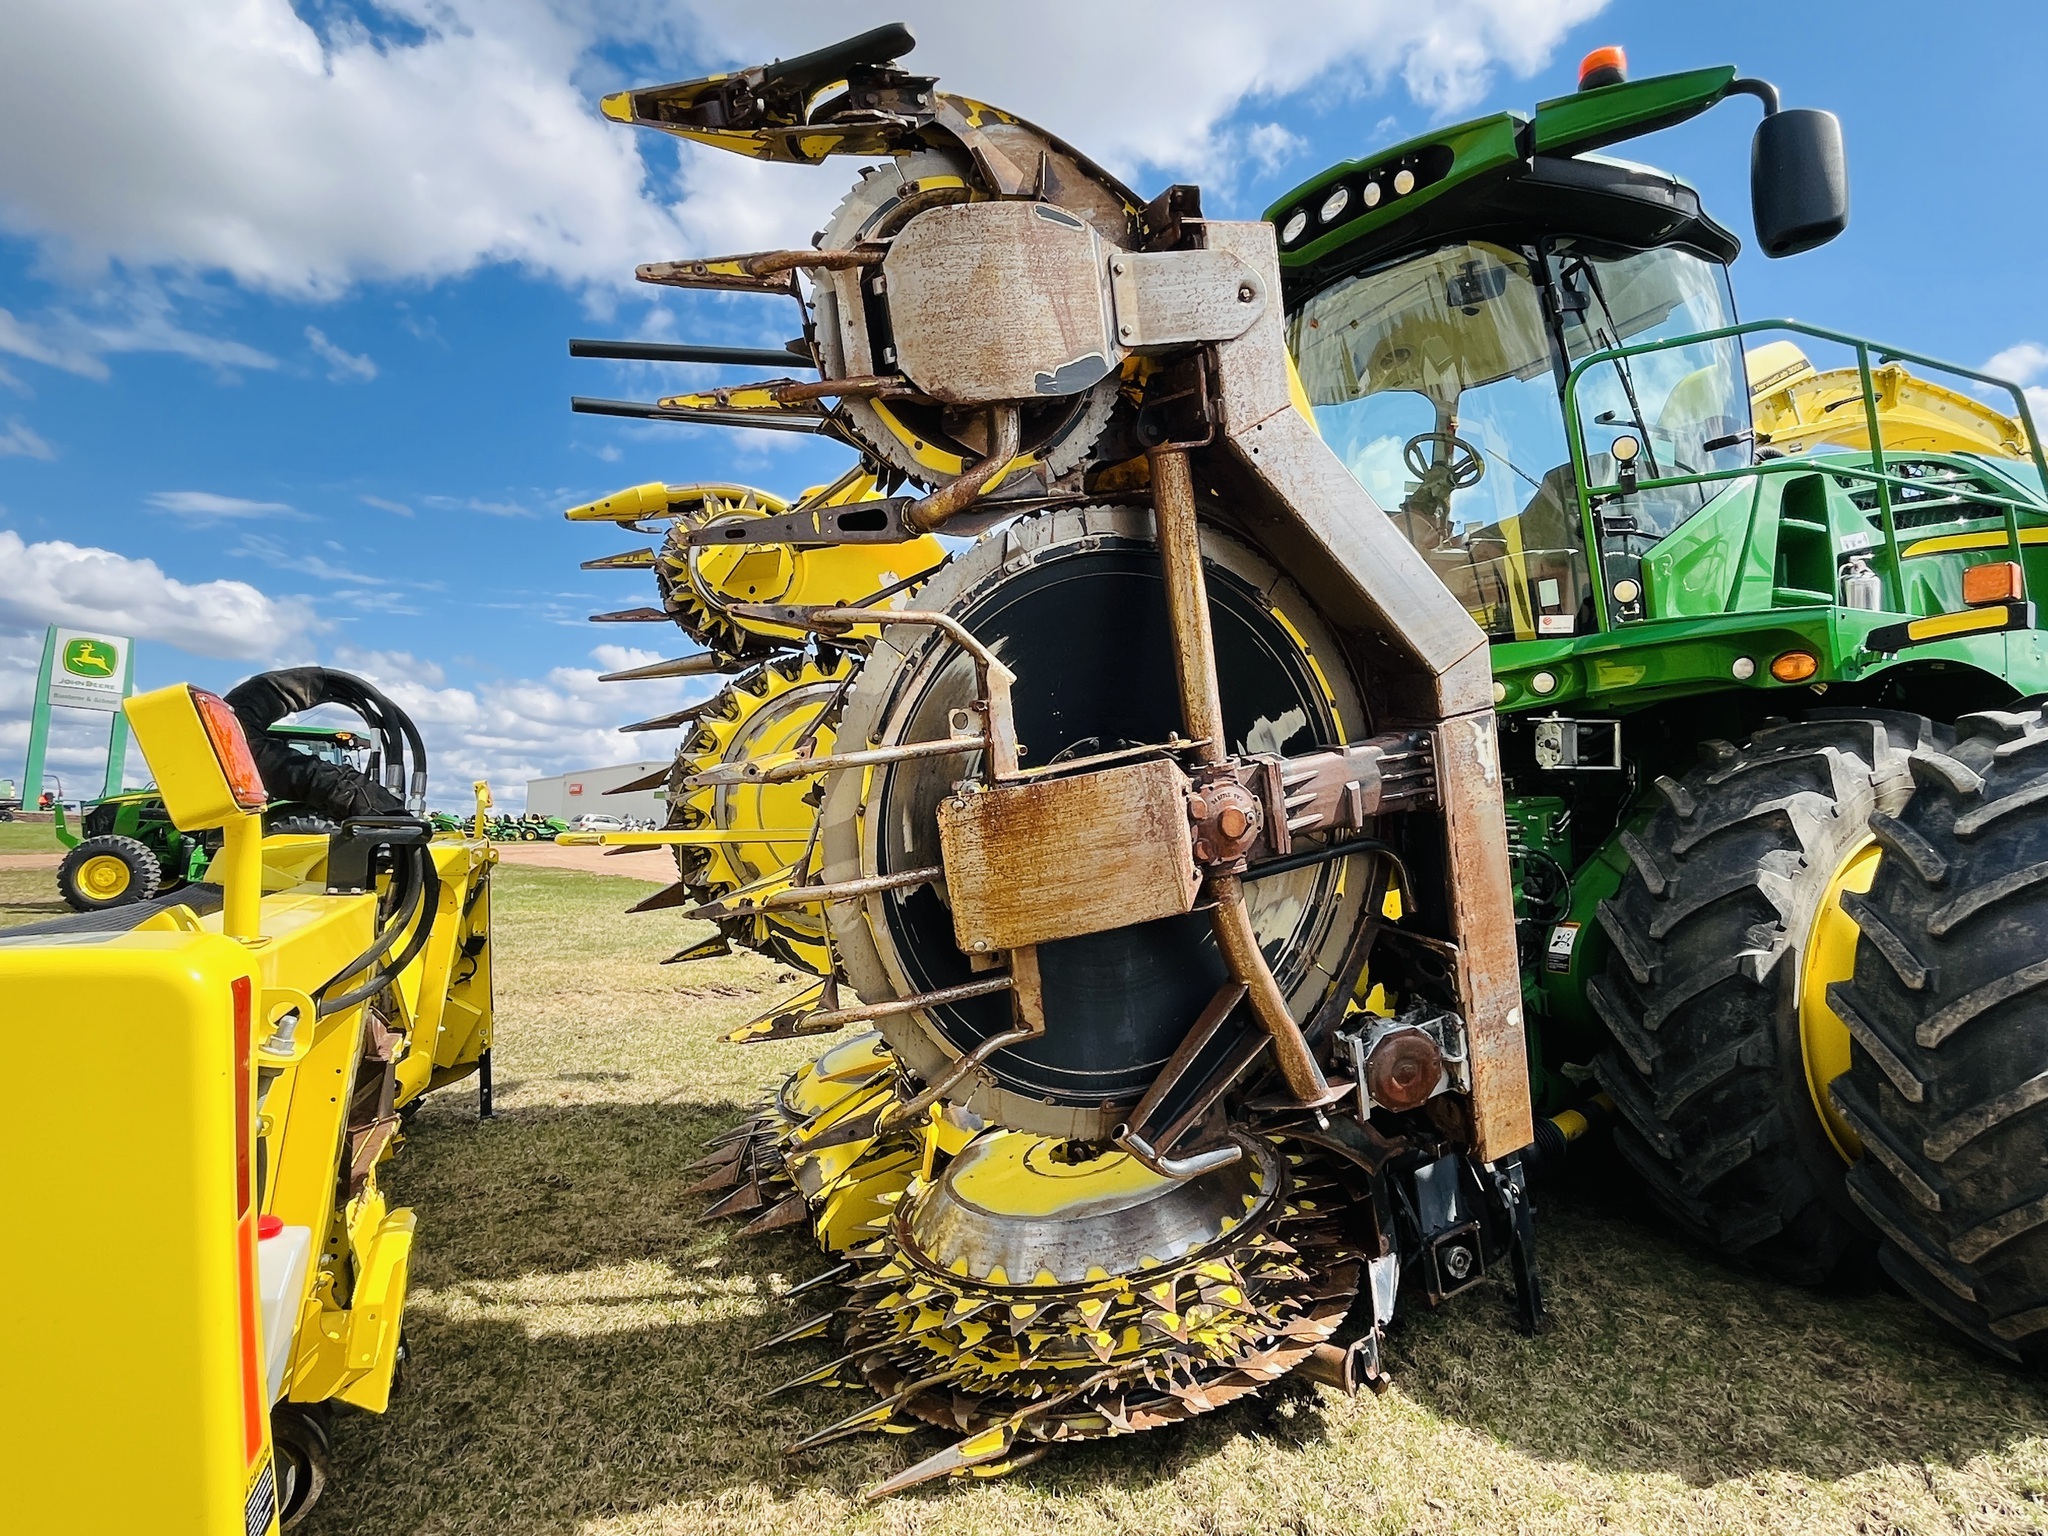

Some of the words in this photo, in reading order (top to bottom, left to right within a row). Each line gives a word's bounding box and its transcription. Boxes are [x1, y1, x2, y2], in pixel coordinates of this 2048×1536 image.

[1754, 371, 1788, 392] HarvestLab
[58, 678, 85, 686] JOHN
[85, 681, 115, 689] DEERE
